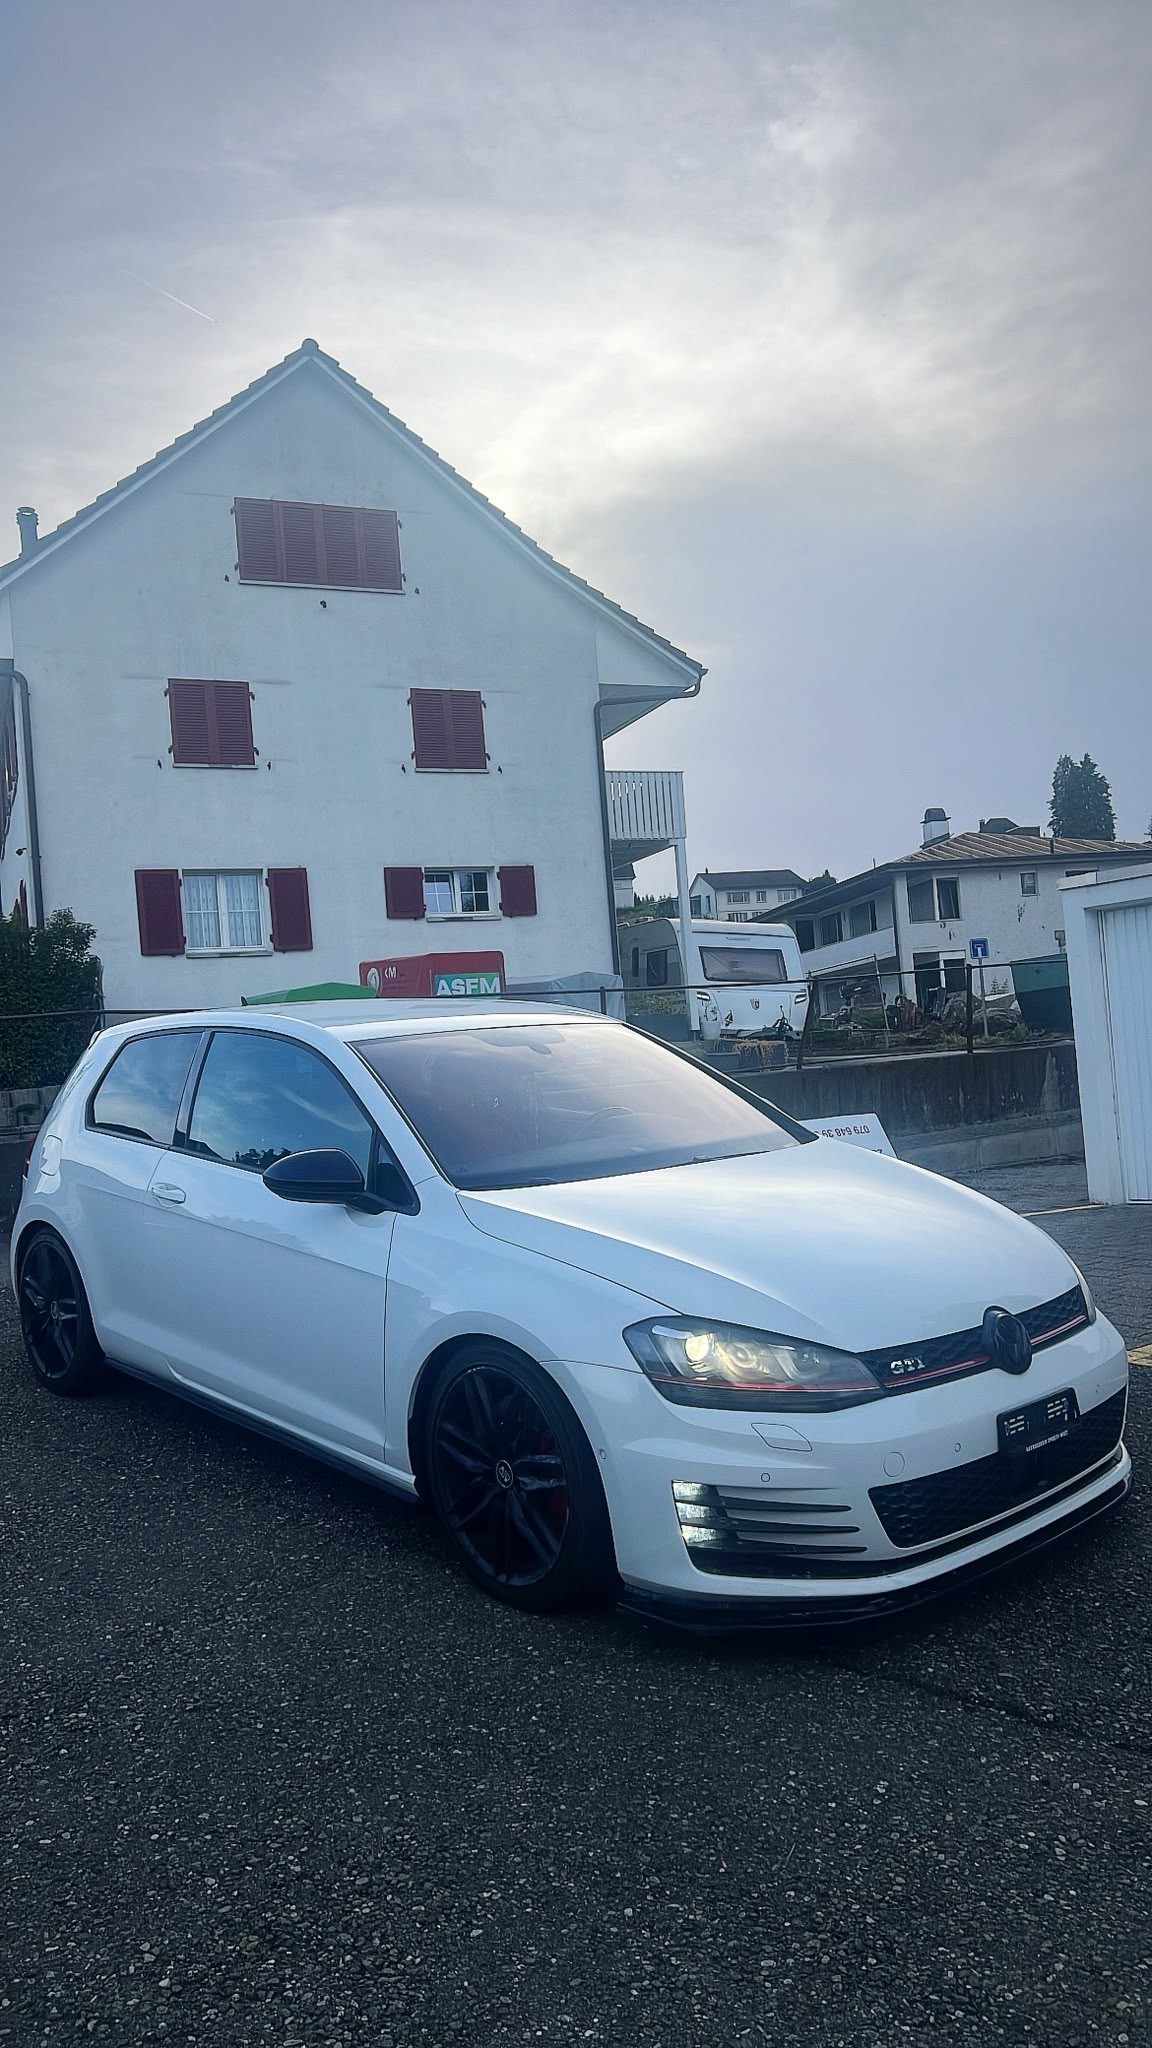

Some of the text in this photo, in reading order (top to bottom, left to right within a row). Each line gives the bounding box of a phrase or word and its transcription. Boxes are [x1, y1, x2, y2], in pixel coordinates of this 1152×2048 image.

[436, 977, 500, 996] ASFM
[835, 1127, 852, 1137] 648
[853, 1125, 870, 1134] 079
[890, 1357, 925, 1375] GTI
